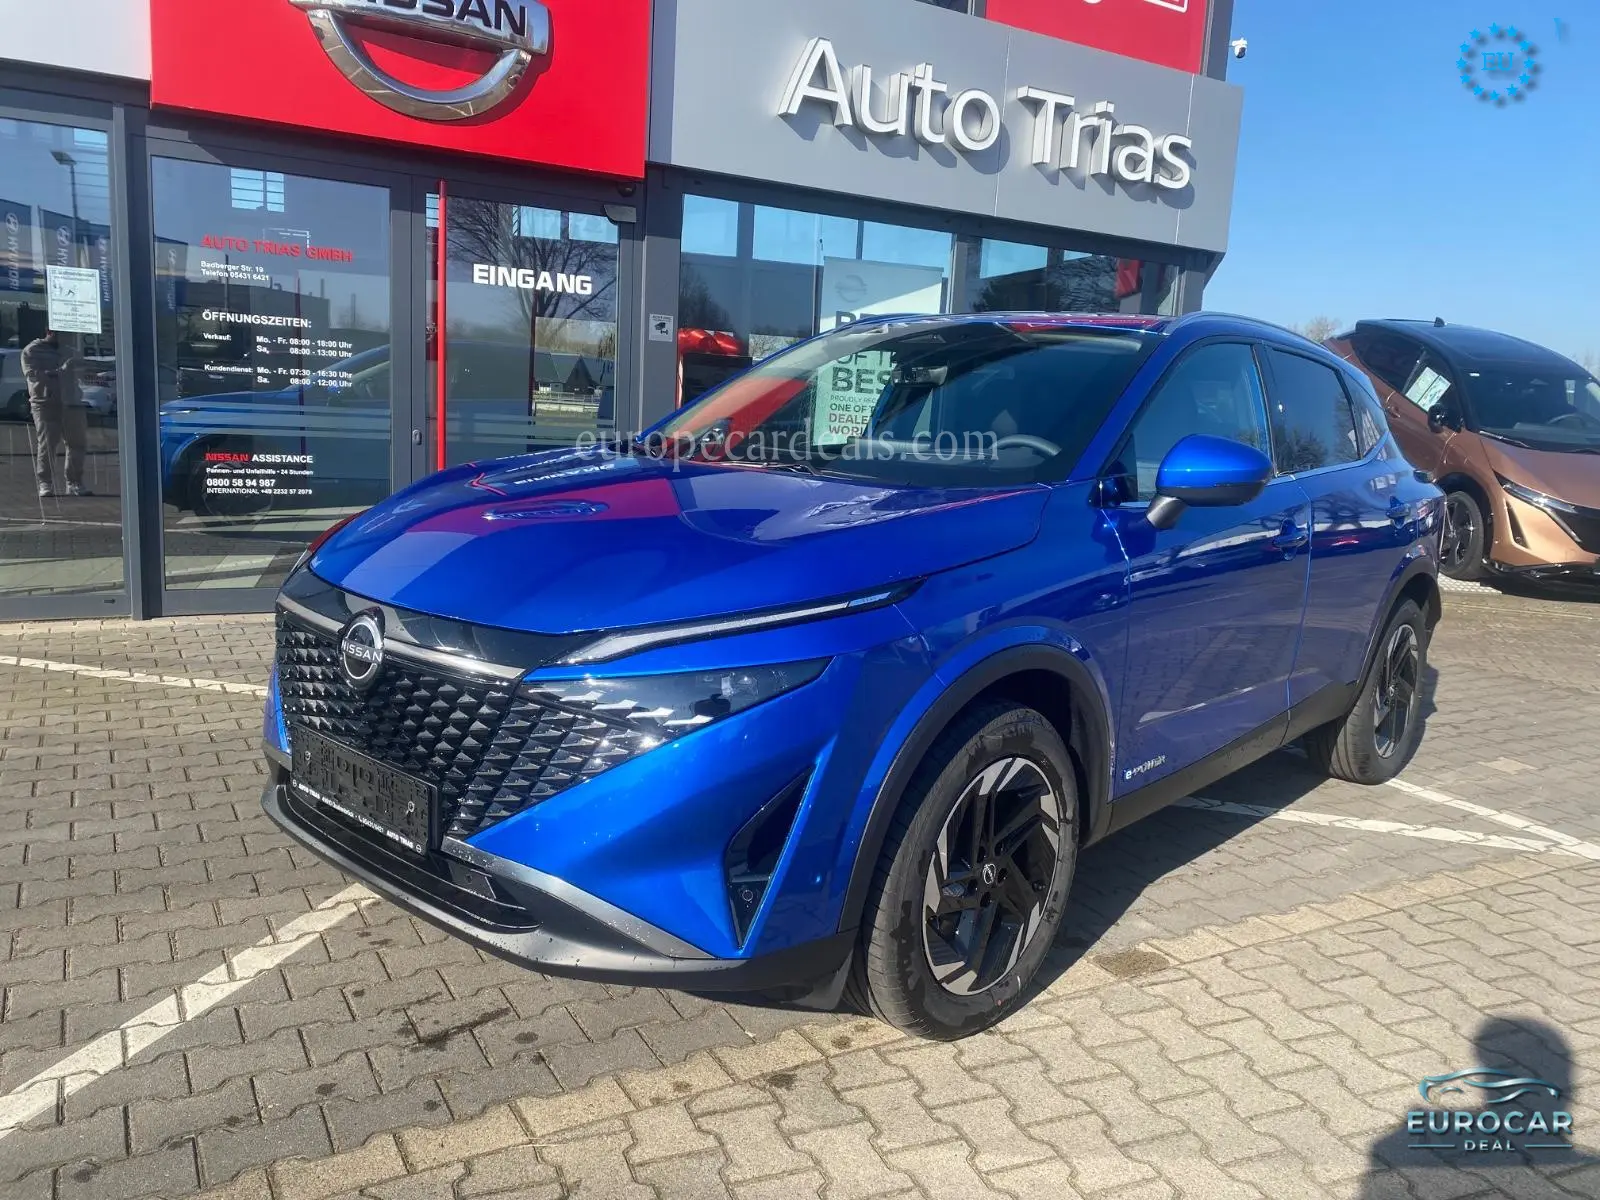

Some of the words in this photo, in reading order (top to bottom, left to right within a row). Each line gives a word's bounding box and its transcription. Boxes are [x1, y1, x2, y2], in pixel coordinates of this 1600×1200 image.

[364, 0, 527, 37] SAN
[778, 36, 1000, 152] Auto
[1016, 85, 1192, 190] Trias
[201, 234, 248, 252] AUTO
[254, 240, 300, 257] TRIAS
[305, 246, 353, 263] GMBH
[200, 260, 240, 272] Badberger
[201, 268, 229, 277] Telefon
[473, 263, 592, 295] EINGANG
[202, 309, 312, 328] ÖFFNUNGSZEITEN:
[203, 332, 232, 341] Verkauf:
[256, 335, 271, 344] Mo.
[277, 337, 288, 345] Fr.
[289, 338, 310, 346] 08:00
[338, 341, 352, 349] Uhr
[289, 347, 310, 356] 08:00
[317, 349, 337, 357] 13:00
[338, 350, 352, 358] Uhr
[204, 364, 254, 373] Kundendienst:
[256, 366, 271, 374] Mo.
[289, 368, 310, 377] 07:30
[338, 371, 352, 379] Uhr
[257, 375, 270, 384] Sa.
[289, 377, 310, 386] 08:00
[317, 379, 337, 387] 12:00
[338, 380, 352, 388] Uhr
[831, 366, 891, 394] BES
[829, 402, 851, 411] ONE
[853, 404, 868, 413] OF
[829, 413, 868, 425] DEALE
[205, 453, 249, 462] NISSAN
[251, 454, 314, 463] ASSISTANCE
[206, 478, 230, 487] 0800
[231, 478, 243, 487] 58
[245, 478, 257, 488] 94
[259, 479, 276, 488] 987
[206, 487, 260, 495] INTERNATIONAL
[341, 639, 383, 662] NISSAN
